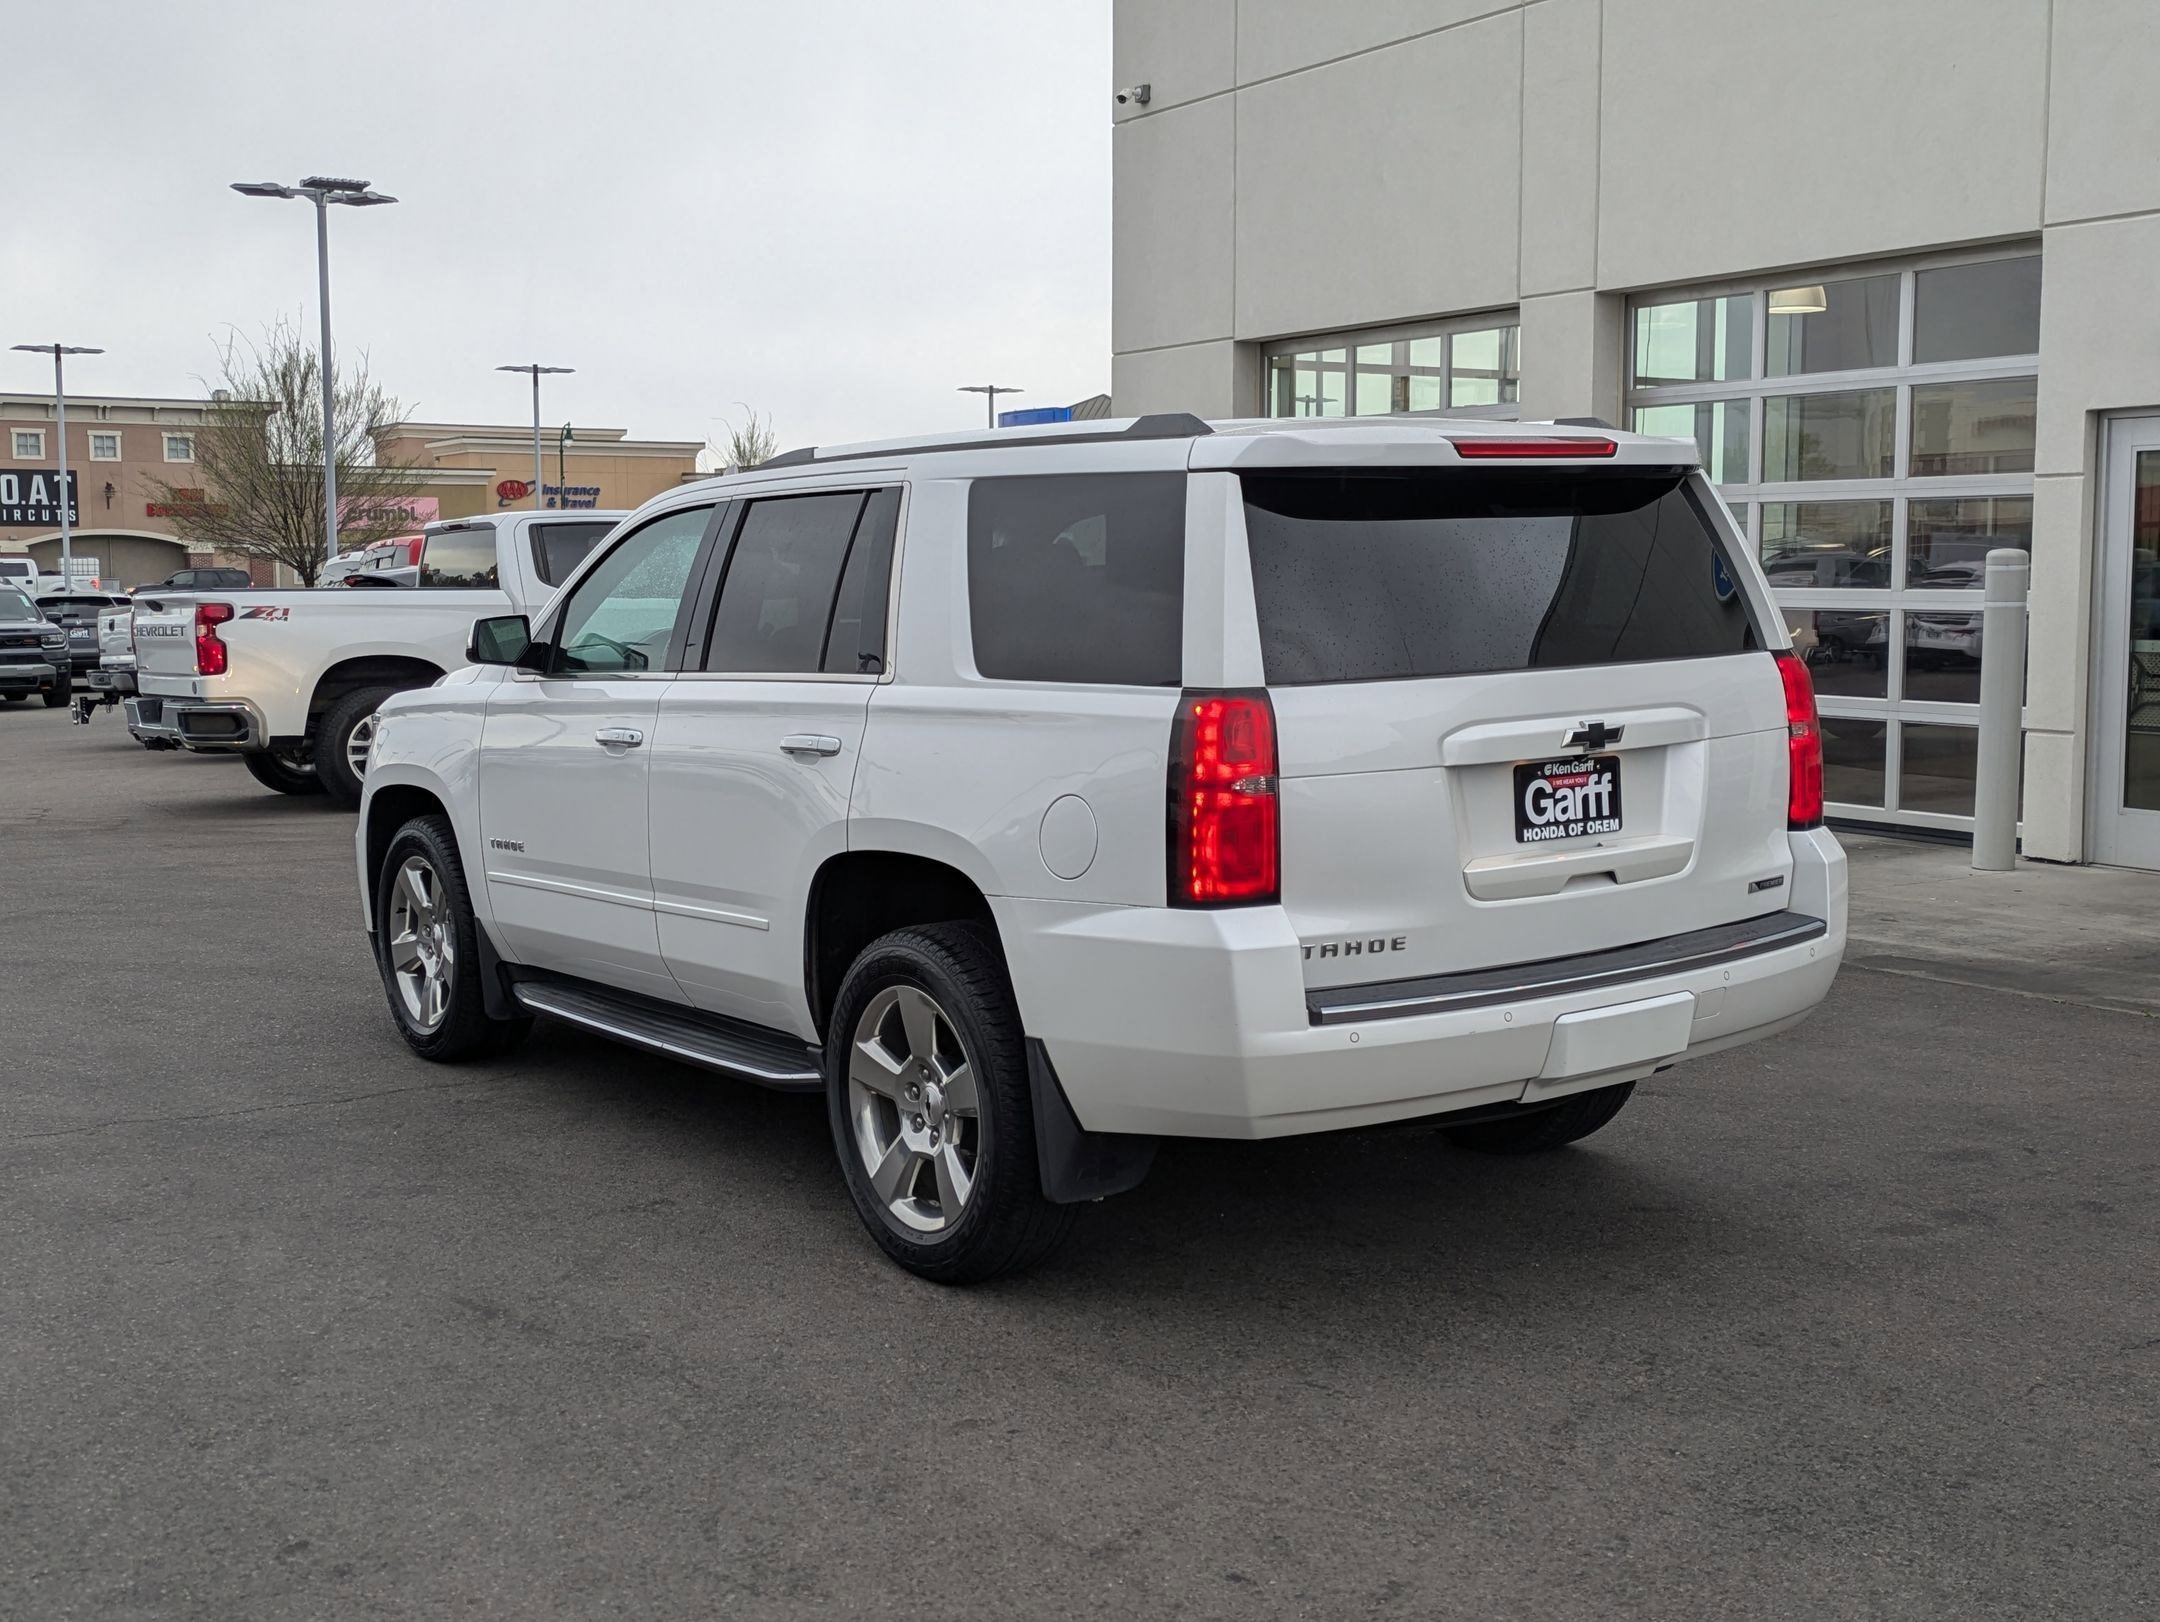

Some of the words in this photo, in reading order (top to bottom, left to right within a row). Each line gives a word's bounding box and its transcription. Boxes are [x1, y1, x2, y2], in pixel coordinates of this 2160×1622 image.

[542, 484, 600, 496] Insurance
[547, 497, 556, 508] &
[1552, 762, 1570, 775] Ken
[1571, 760, 1595, 773] Garff
[1525, 772, 1612, 825] Garff
[1523, 827, 1566, 842] HONDA
[1568, 822, 1585, 836] OF
[1587, 818, 1620, 834] OREM
[489, 838, 525, 853] TAHOE
[1301, 936, 1407, 960] TAHOE
